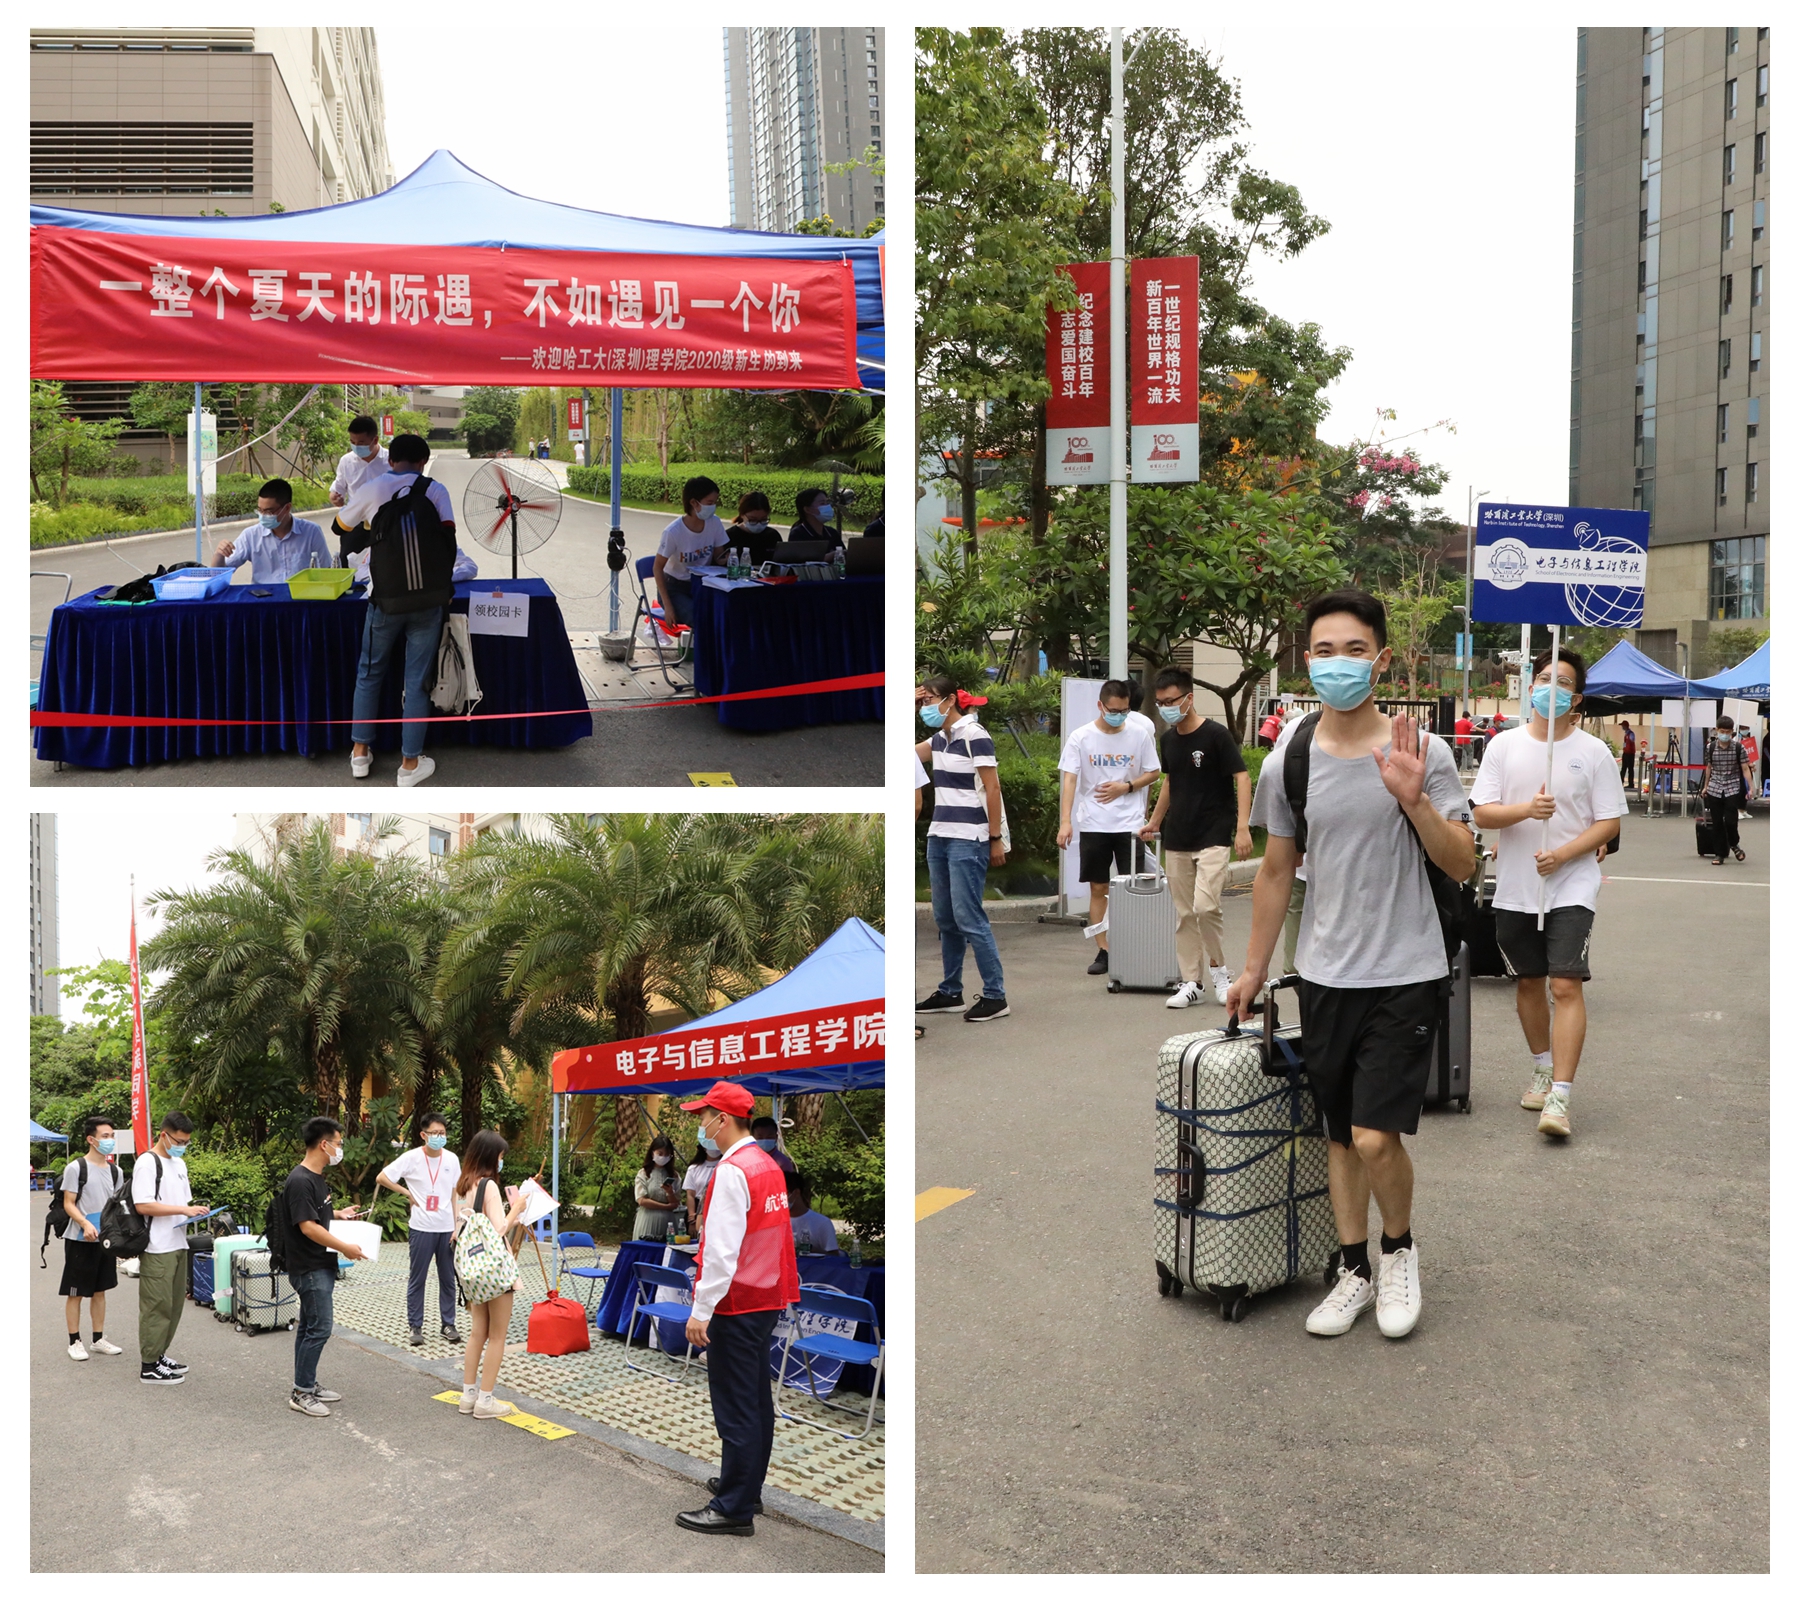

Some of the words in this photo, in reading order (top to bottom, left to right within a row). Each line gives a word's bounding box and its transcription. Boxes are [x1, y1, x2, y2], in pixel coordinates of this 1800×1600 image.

[1060, 311, 1076, 399] 志爱国奋斗
[1078, 292, 1094, 398] 纪念建校百年
[1146, 279, 1163, 404] 新百年世界一流
[1164, 283, 1181, 404] 一世纪规格功夫
[474, 604, 522, 618] 领校园卡
[615, 1012, 885, 1076] 电子与信息工程学院
